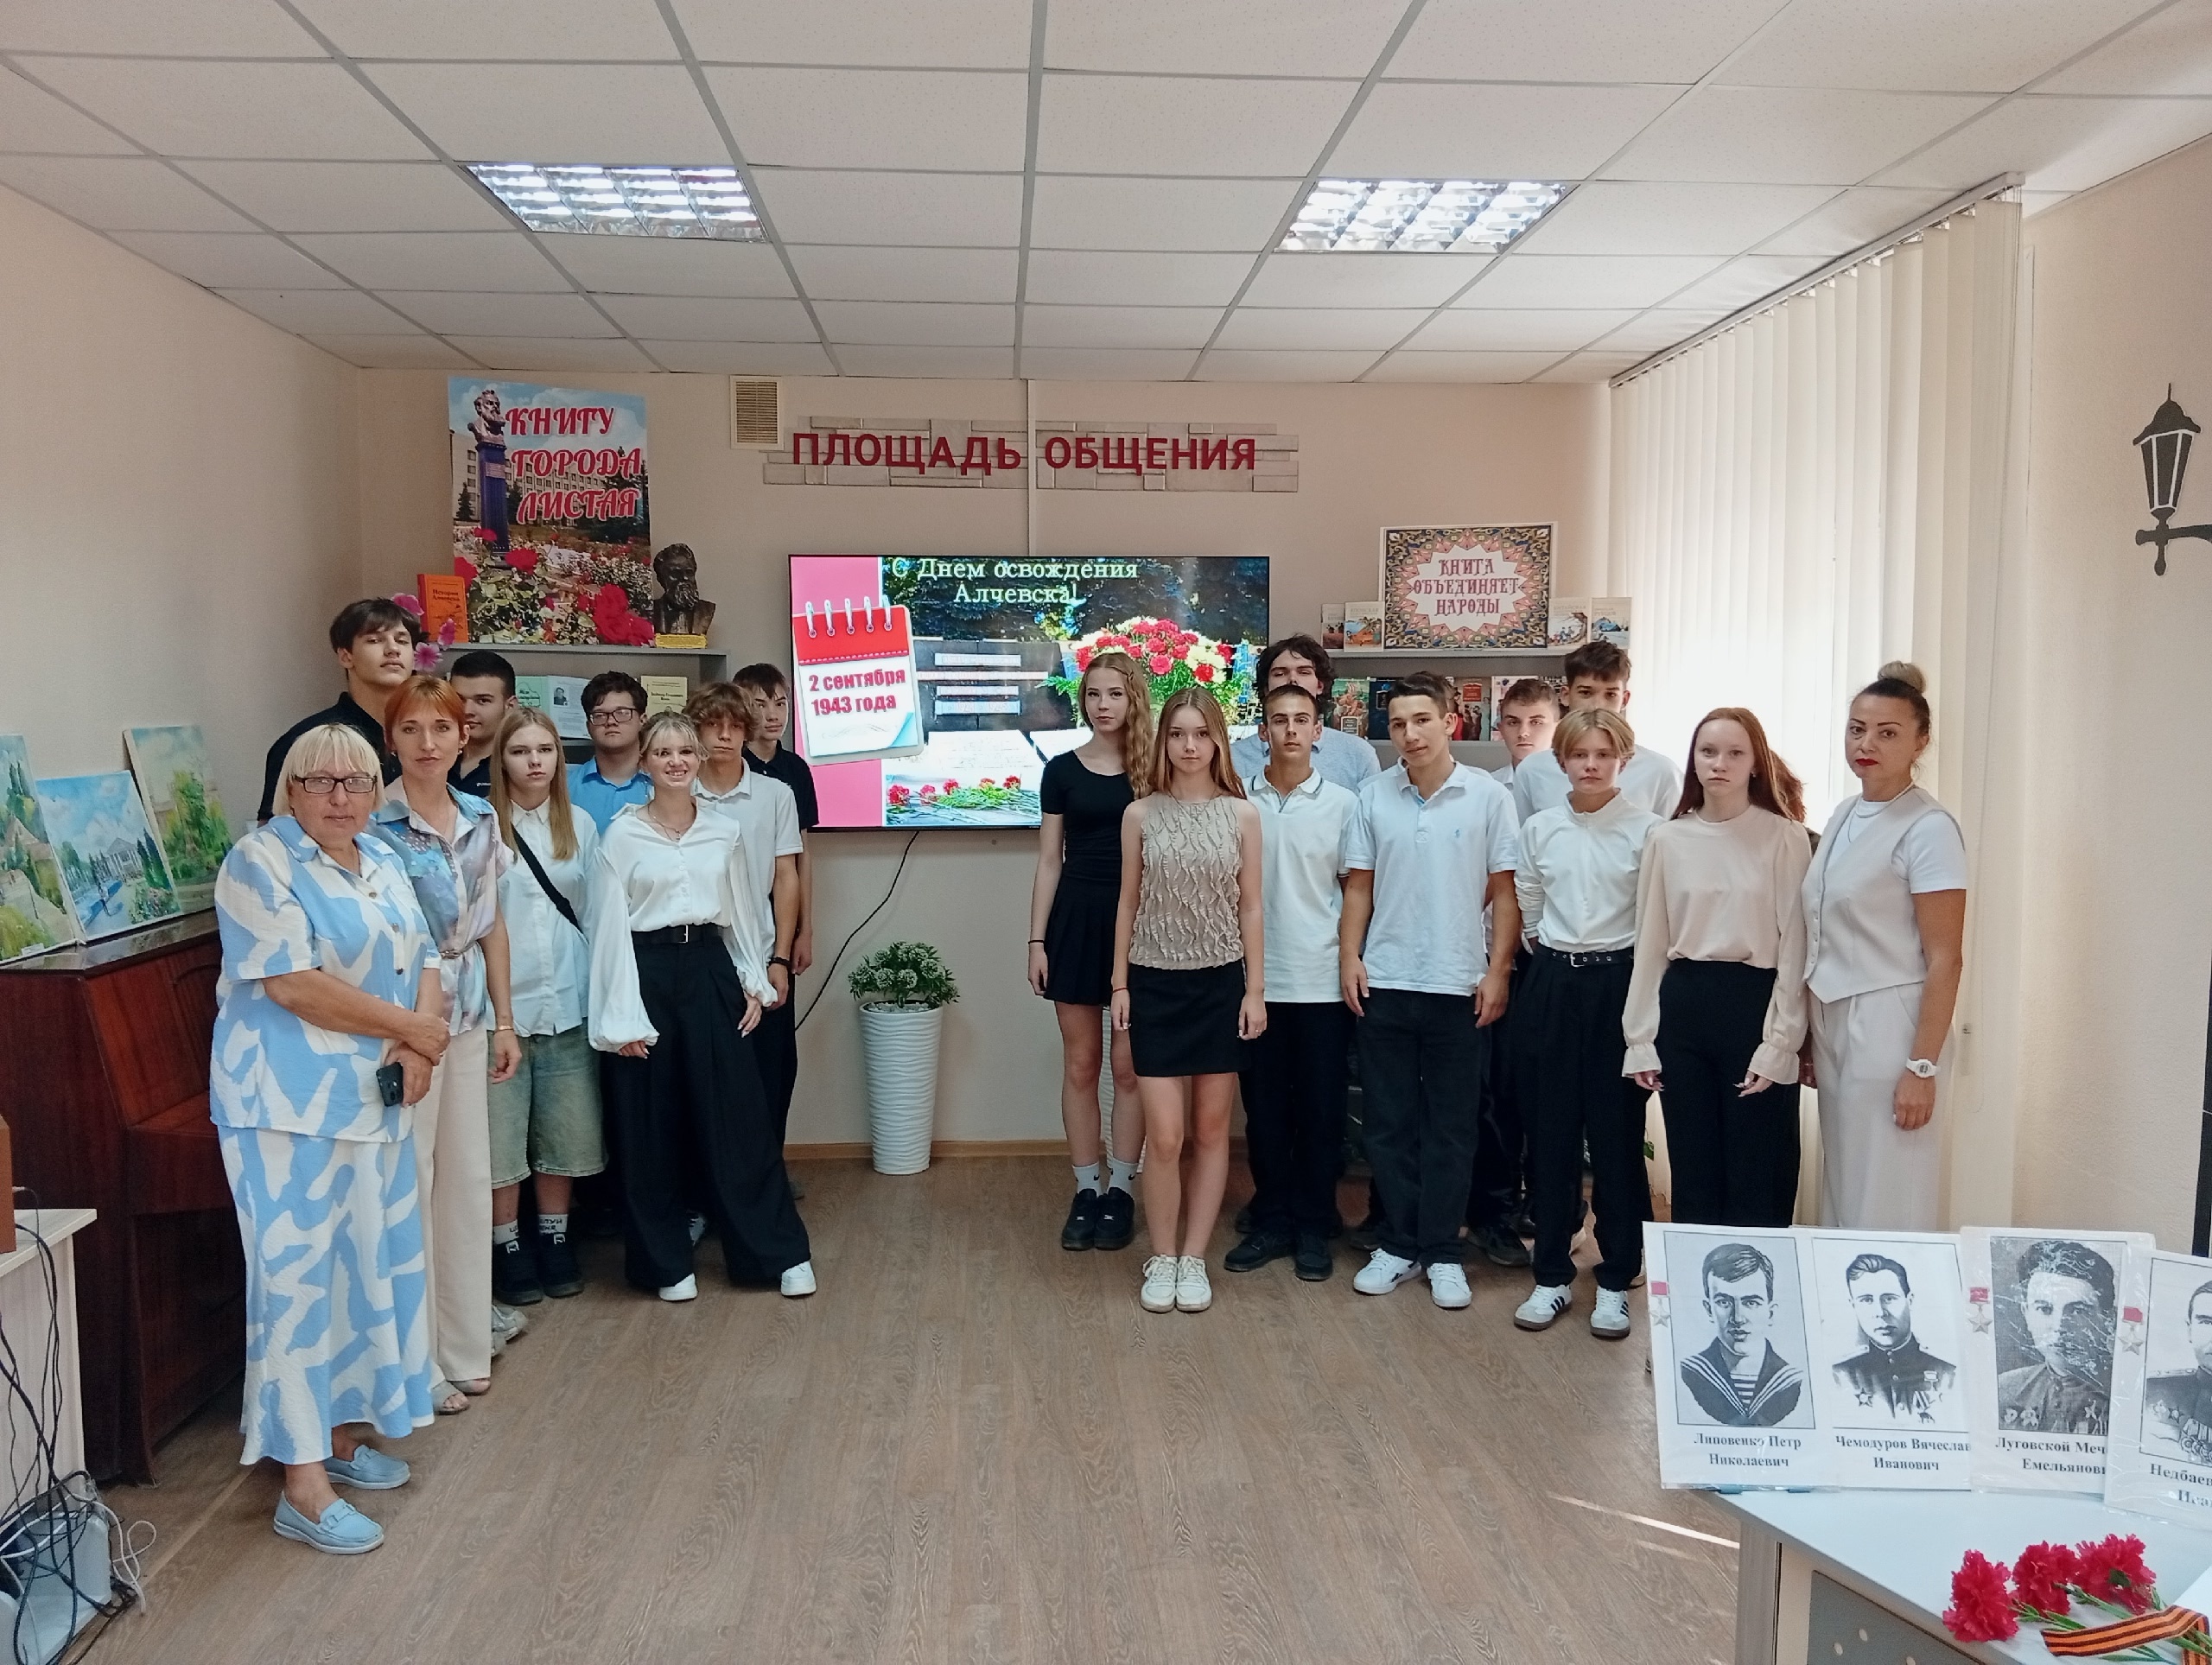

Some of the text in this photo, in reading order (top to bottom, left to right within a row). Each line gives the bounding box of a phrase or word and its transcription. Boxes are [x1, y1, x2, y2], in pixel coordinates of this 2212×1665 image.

[505, 407, 614, 435] КНИГУ
[512, 448, 641, 480] ГОРОДА
[793, 433, 1255, 476] ПЛОЩАДЬ ОБЩЕНИЯ
[517, 488, 640, 524] ЛИСТАЯ
[892, 557, 1139, 581] С Днем освождения
[1439, 558, 1495, 577] КНИГА
[953, 583, 1077, 604] Алчевска!
[1414, 578, 1519, 597] ОБЪЕДИНЯЕТ
[1434, 599, 1501, 616] НАРОДЫ
[809, 674, 820, 692] 2
[823, 669, 906, 691] сентября
[811, 695, 897, 715] 1943 года
[1694, 1433, 1802, 1450] Липовенко Петр
[1835, 1435, 1908, 1452] Чемодуров
[1995, 1437, 2070, 1452] Луговской
[1709, 1453, 1789, 1467] Николаевич
[1873, 1457, 1939, 1471] Иванович
